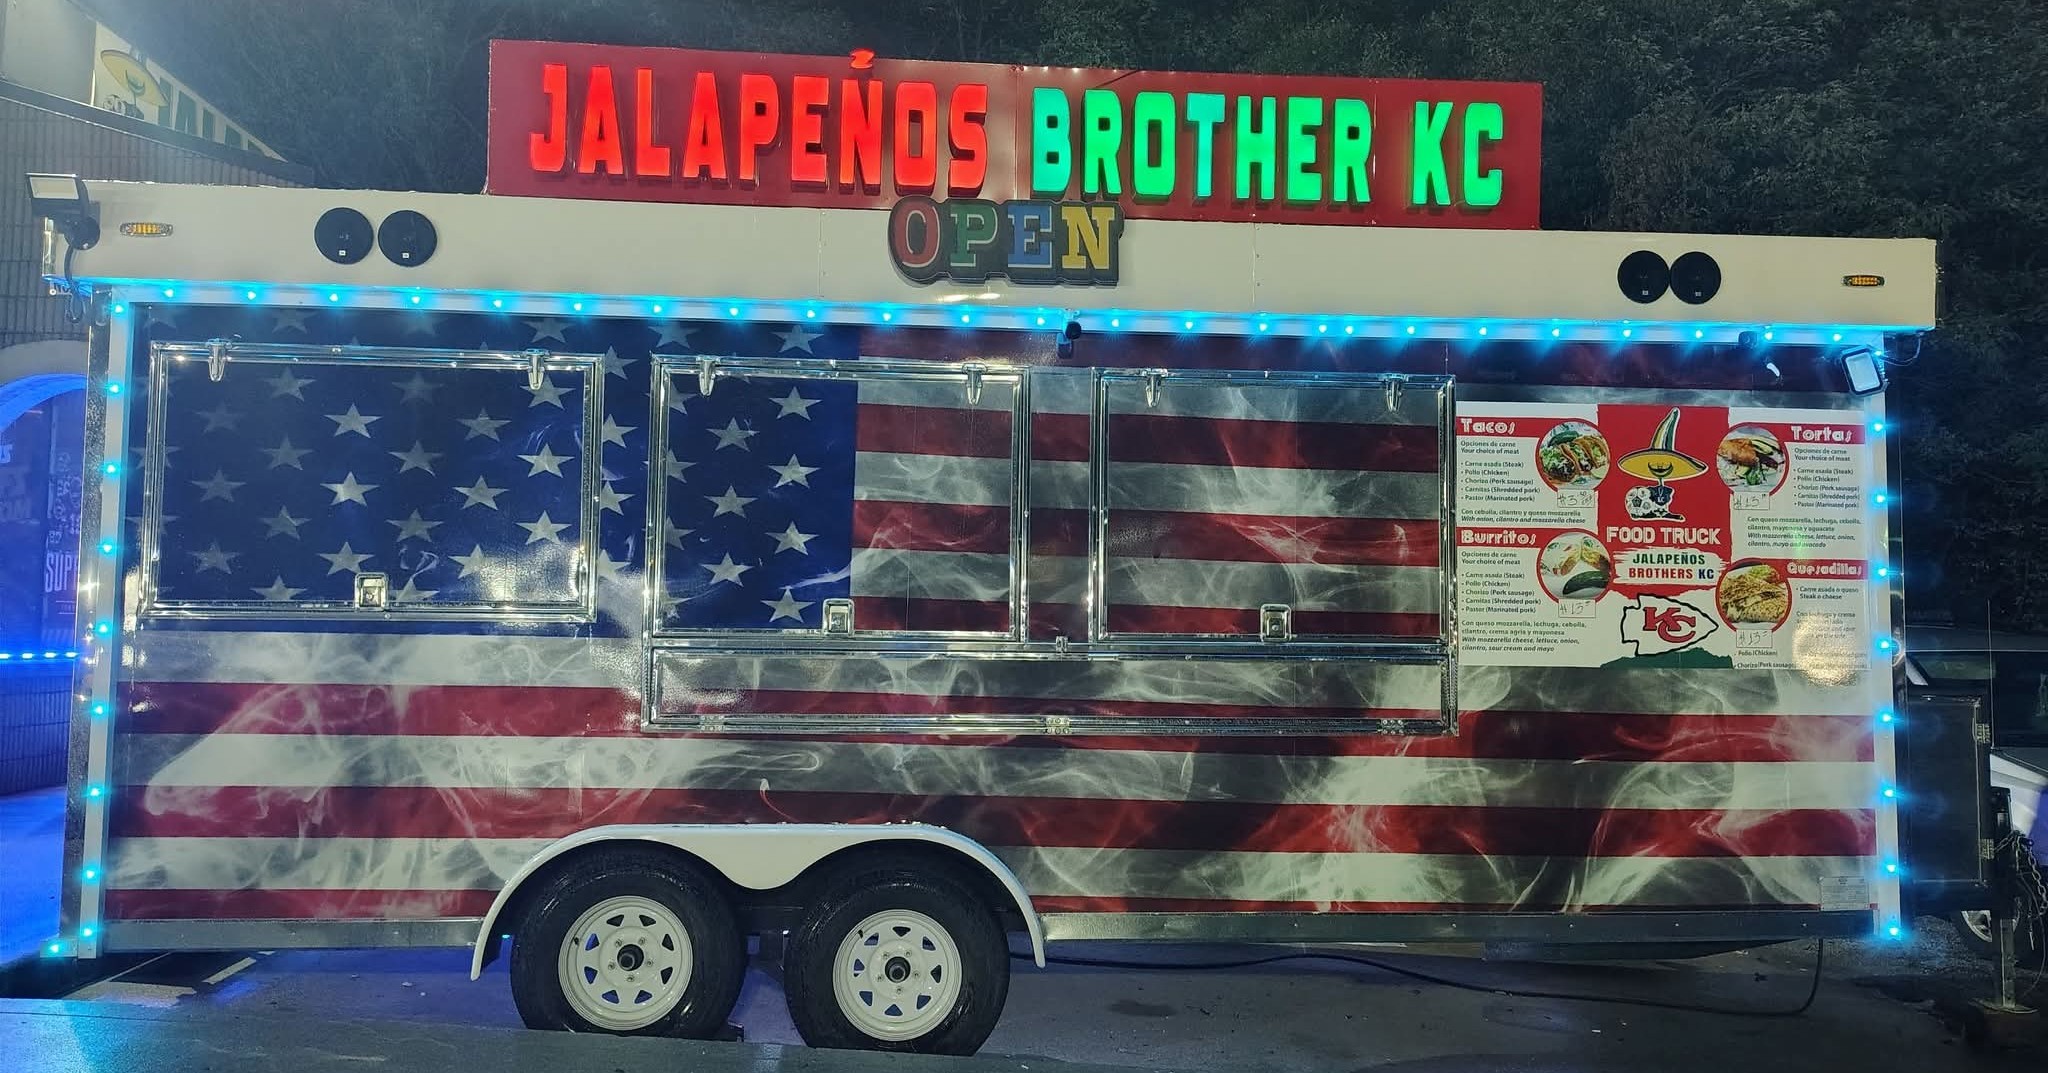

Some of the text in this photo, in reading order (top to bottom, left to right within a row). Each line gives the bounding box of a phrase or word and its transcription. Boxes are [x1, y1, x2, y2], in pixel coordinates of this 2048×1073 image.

[530, 49, 1503, 207] JALAPEÑOS BROTHER KC
[895, 202, 1116, 270] OPEN
[1460, 418, 1516, 435] Tacos
[1791, 426, 1852, 443] Tortas
[1461, 529, 1536, 545] Burritos
[1606, 526, 1721, 544] FOOD TRUCK
[1633, 552, 1705, 565] JALAPEÑOS
[1629, 568, 1714, 579] BROTHERS KC
[1786, 562, 1862, 577] Quesadillas
[1642, 607, 1696, 643] KC
